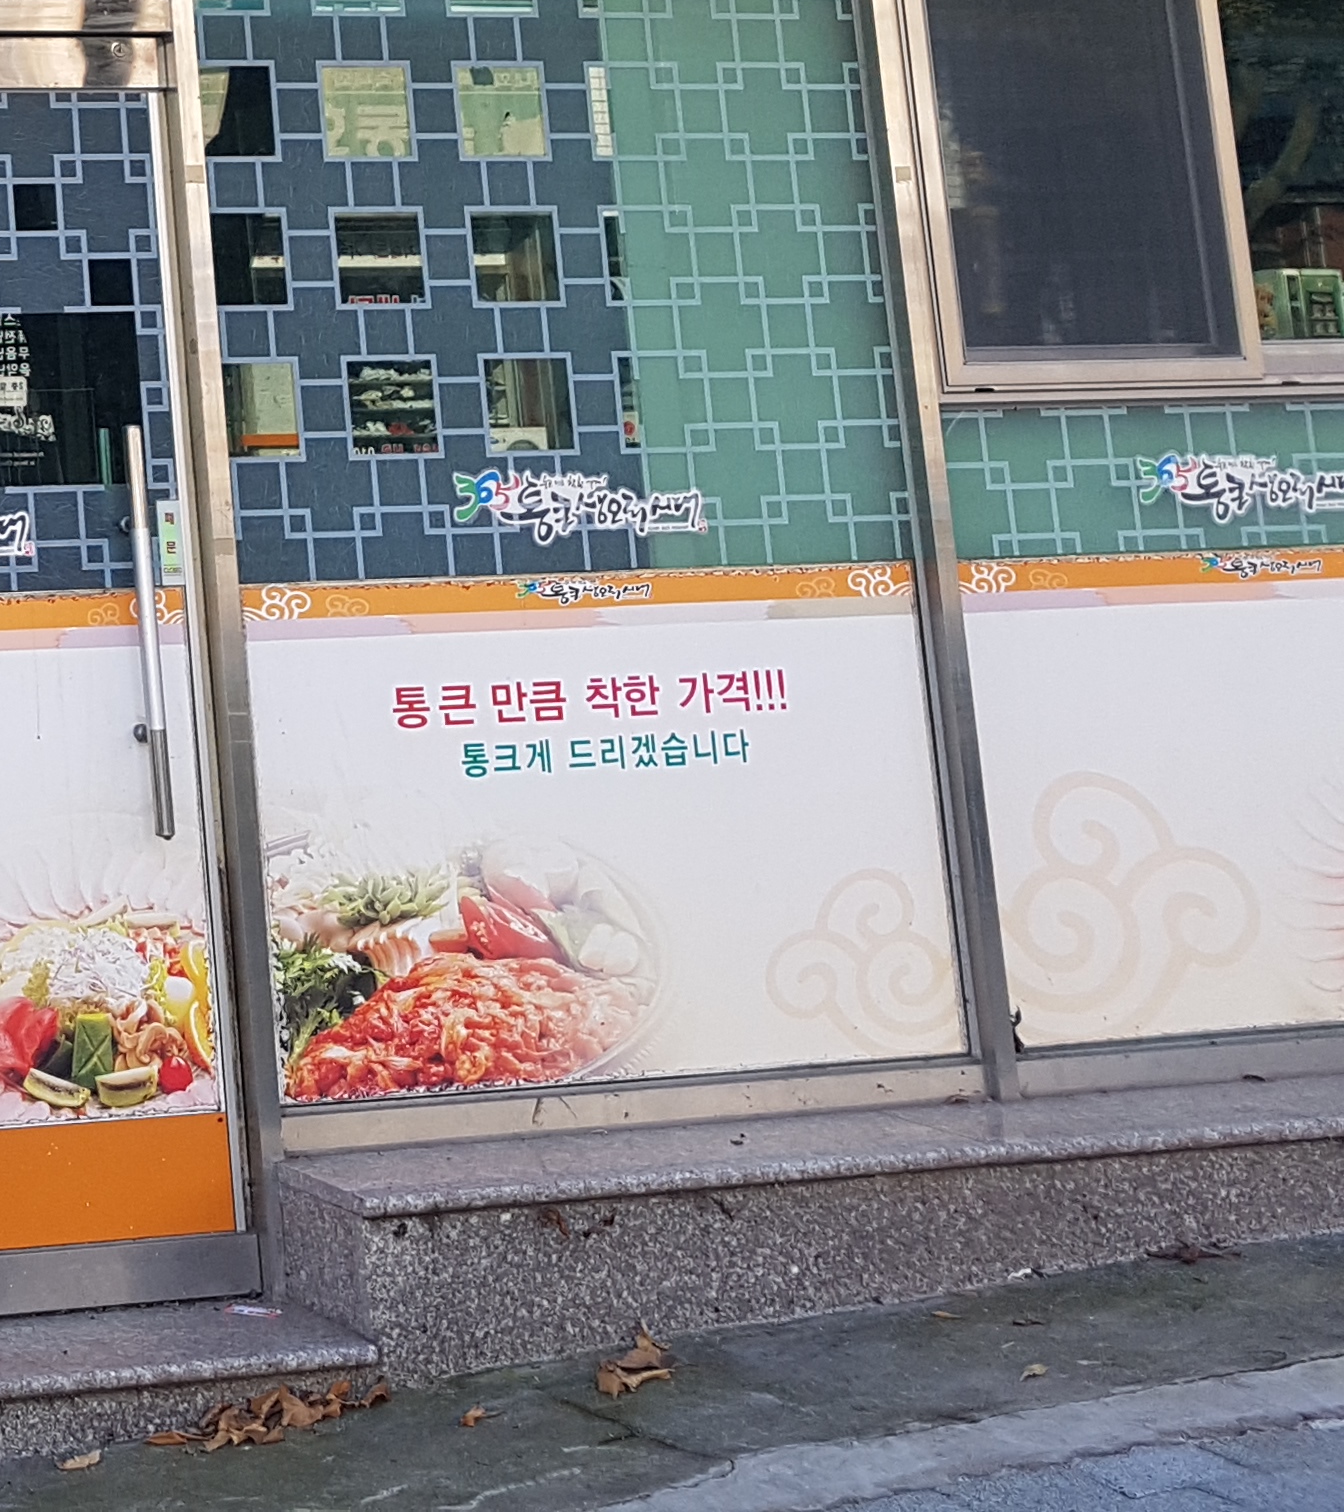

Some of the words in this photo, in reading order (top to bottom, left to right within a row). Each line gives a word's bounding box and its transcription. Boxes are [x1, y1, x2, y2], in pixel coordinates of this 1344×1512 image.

[392, 684, 476, 729] 통큰
[491, 680, 566, 723] 만큼
[585, 674, 659, 718] 착한
[678, 668, 787, 713] 가격!!!
[461, 738, 552, 777] 통크게
[569, 729, 750, 770] 드리겠습니다
